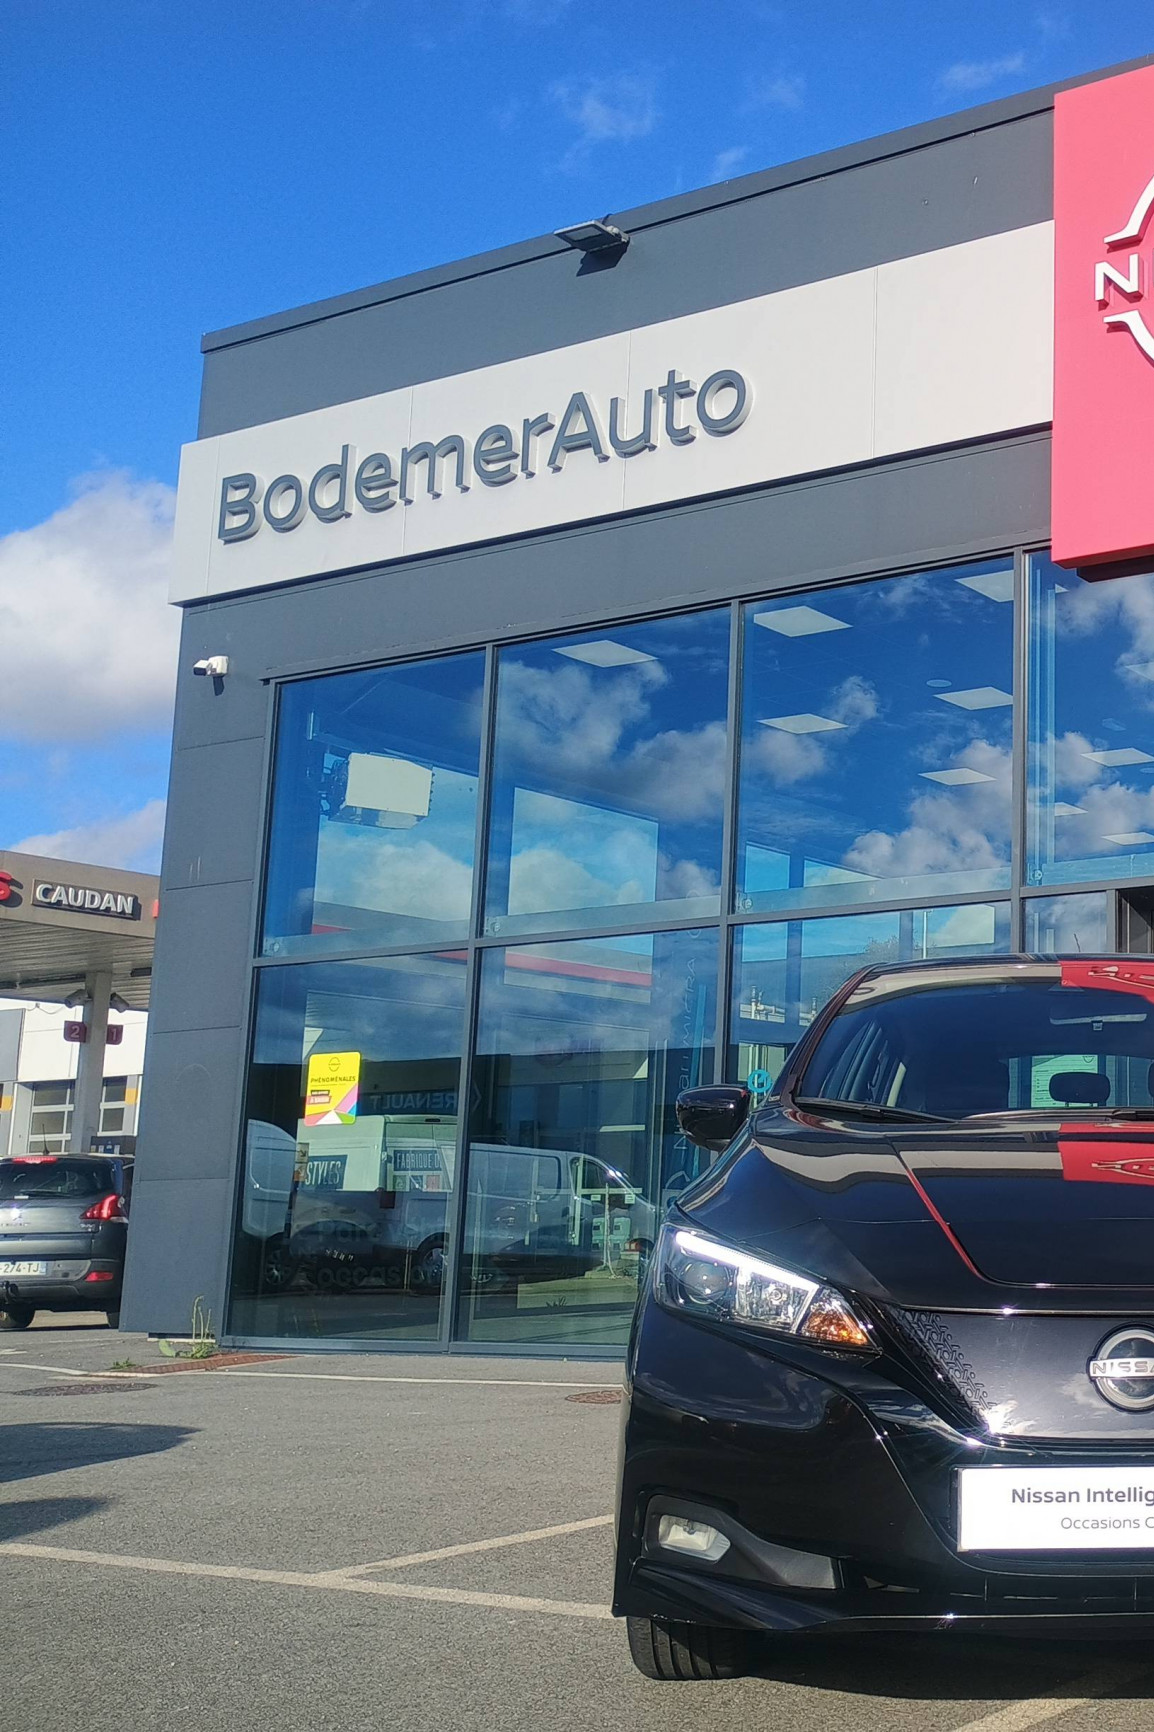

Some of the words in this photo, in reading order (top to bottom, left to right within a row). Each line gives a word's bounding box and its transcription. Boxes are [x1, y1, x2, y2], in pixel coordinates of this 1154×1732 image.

[218, 369, 751, 544] BodemerAuto
[36, 883, 134, 914] CAUDAN
[70, 1026, 80, 1037] 2
[111, 1028, 117, 1040] 1
[396, 1152, 433, 1169] FABRIQUE
[304, 1160, 341, 1186] STYLES
[1011, 1487, 1081, 1503] Nissan
[1060, 1516, 1141, 1530] Occasions
